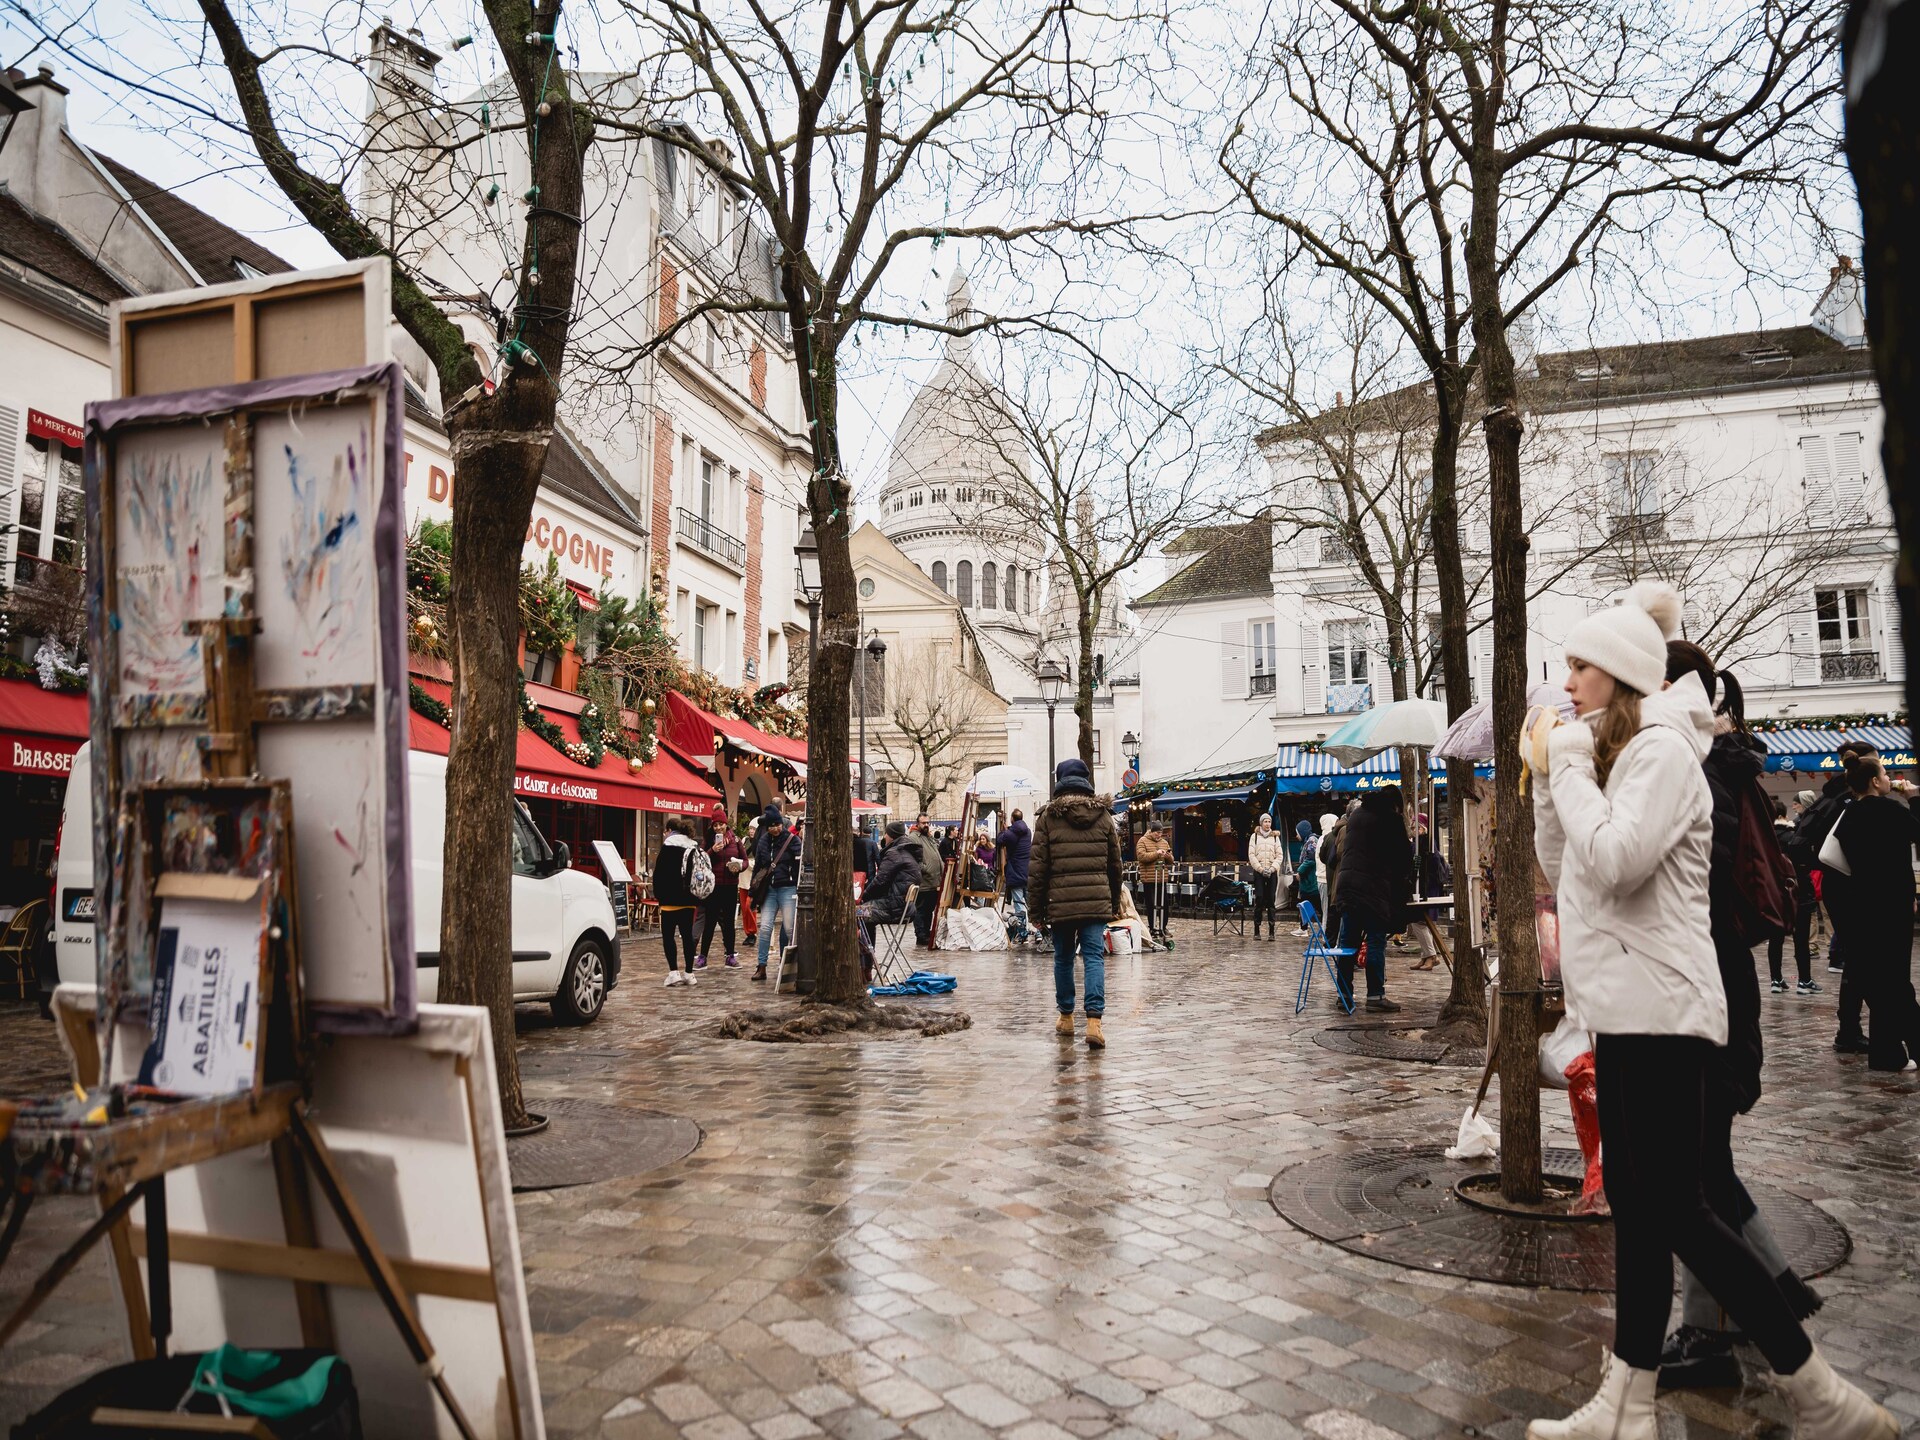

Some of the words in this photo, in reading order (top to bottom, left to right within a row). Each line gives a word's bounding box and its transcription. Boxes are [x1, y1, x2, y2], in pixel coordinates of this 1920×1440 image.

[32, 414, 43, 425] LA
[1820, 756, 1837, 768] Au
[523, 775, 549, 794] CADET
[550, 782, 561, 795] de
[561, 781, 598, 801] GASCOGNE
[1355, 776, 1370, 788] Au
[653, 796, 682, 811] Restaurant
[683, 800, 694, 812] salle
[192, 946, 221, 1077] ABATILLES
